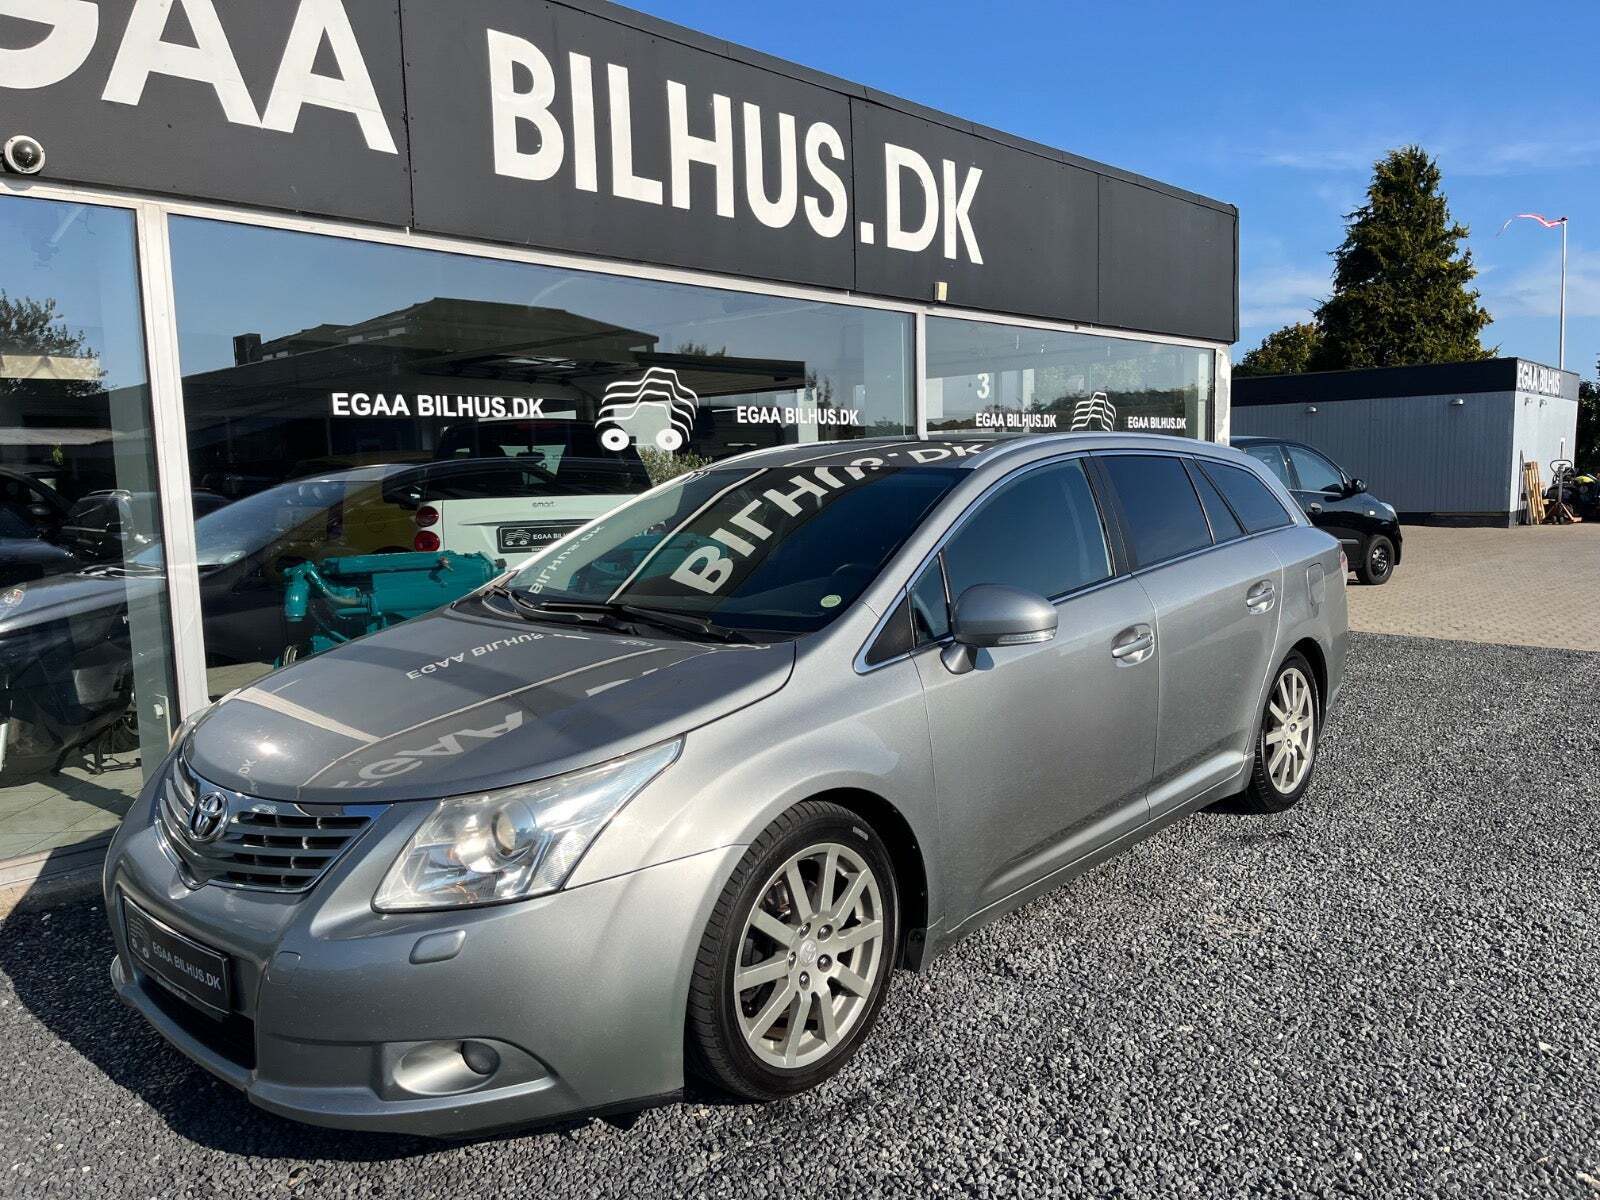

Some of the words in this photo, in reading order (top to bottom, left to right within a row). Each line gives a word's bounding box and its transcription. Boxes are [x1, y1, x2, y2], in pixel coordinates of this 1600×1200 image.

[486, 28, 985, 265] BILHUS.DK
[976, 372, 991, 399] 3
[1516, 362, 1539, 391] EGAA
[331, 392, 412, 417] EGAA
[416, 394, 546, 419] BILHUS.DK
[736, 405, 782, 424] EGAA
[784, 407, 860, 426] BILHUS.DK
[975, 412, 1005, 428] EGAA
[1006, 413, 1057, 428] BILHUS.DK
[1127, 415, 1150, 430] EGAA
[1150, 416, 1187, 430] BILHUS.DK
[152, 941, 174, 965] EGAA
[173, 955, 222, 991] BILHUS.DK
